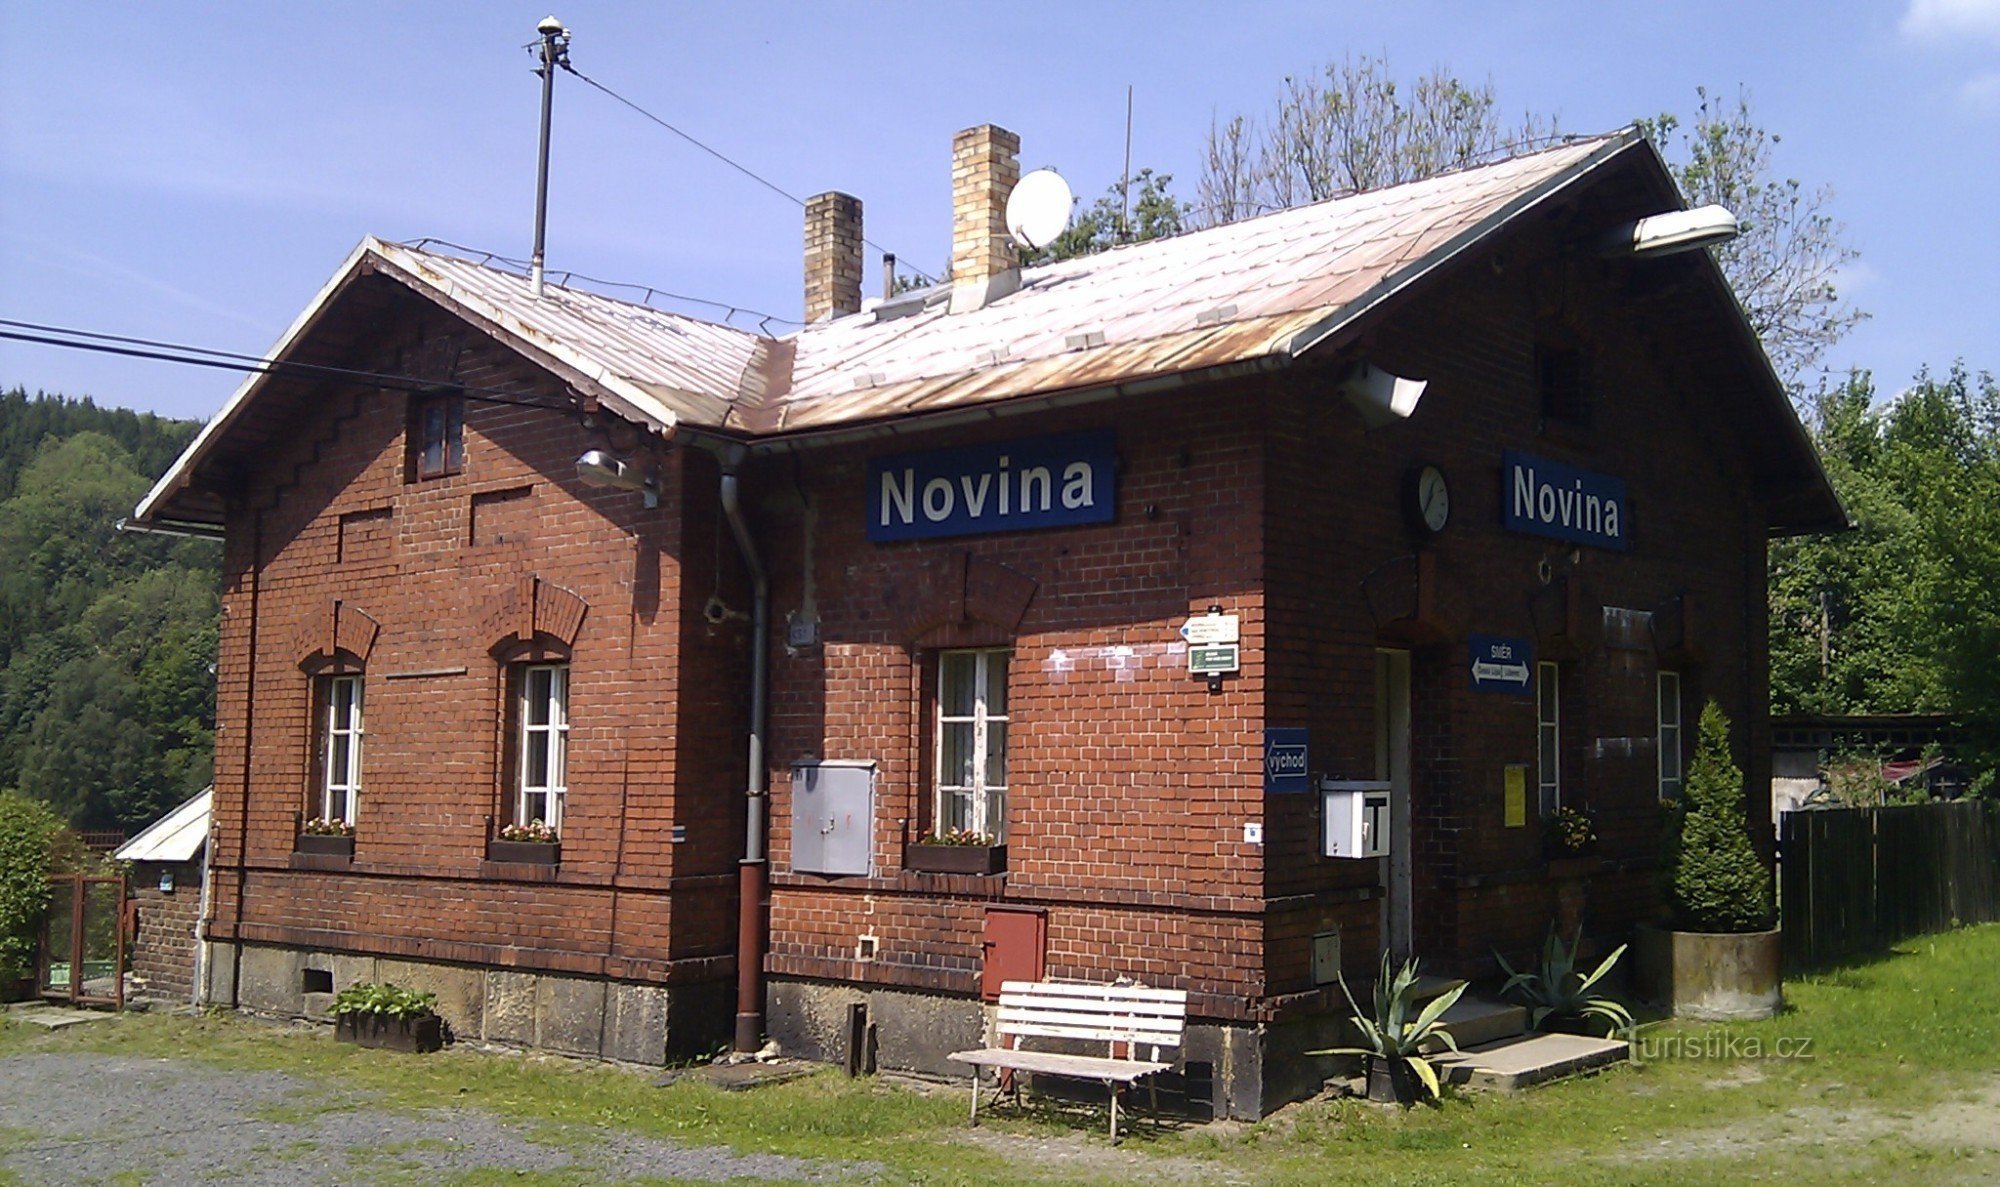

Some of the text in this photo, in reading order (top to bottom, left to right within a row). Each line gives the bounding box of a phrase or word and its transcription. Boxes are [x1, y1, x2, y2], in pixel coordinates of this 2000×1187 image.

[880, 455, 1094, 527] Novina
[1514, 465, 1619, 537] Novina
[1269, 751, 1305, 772] východ
